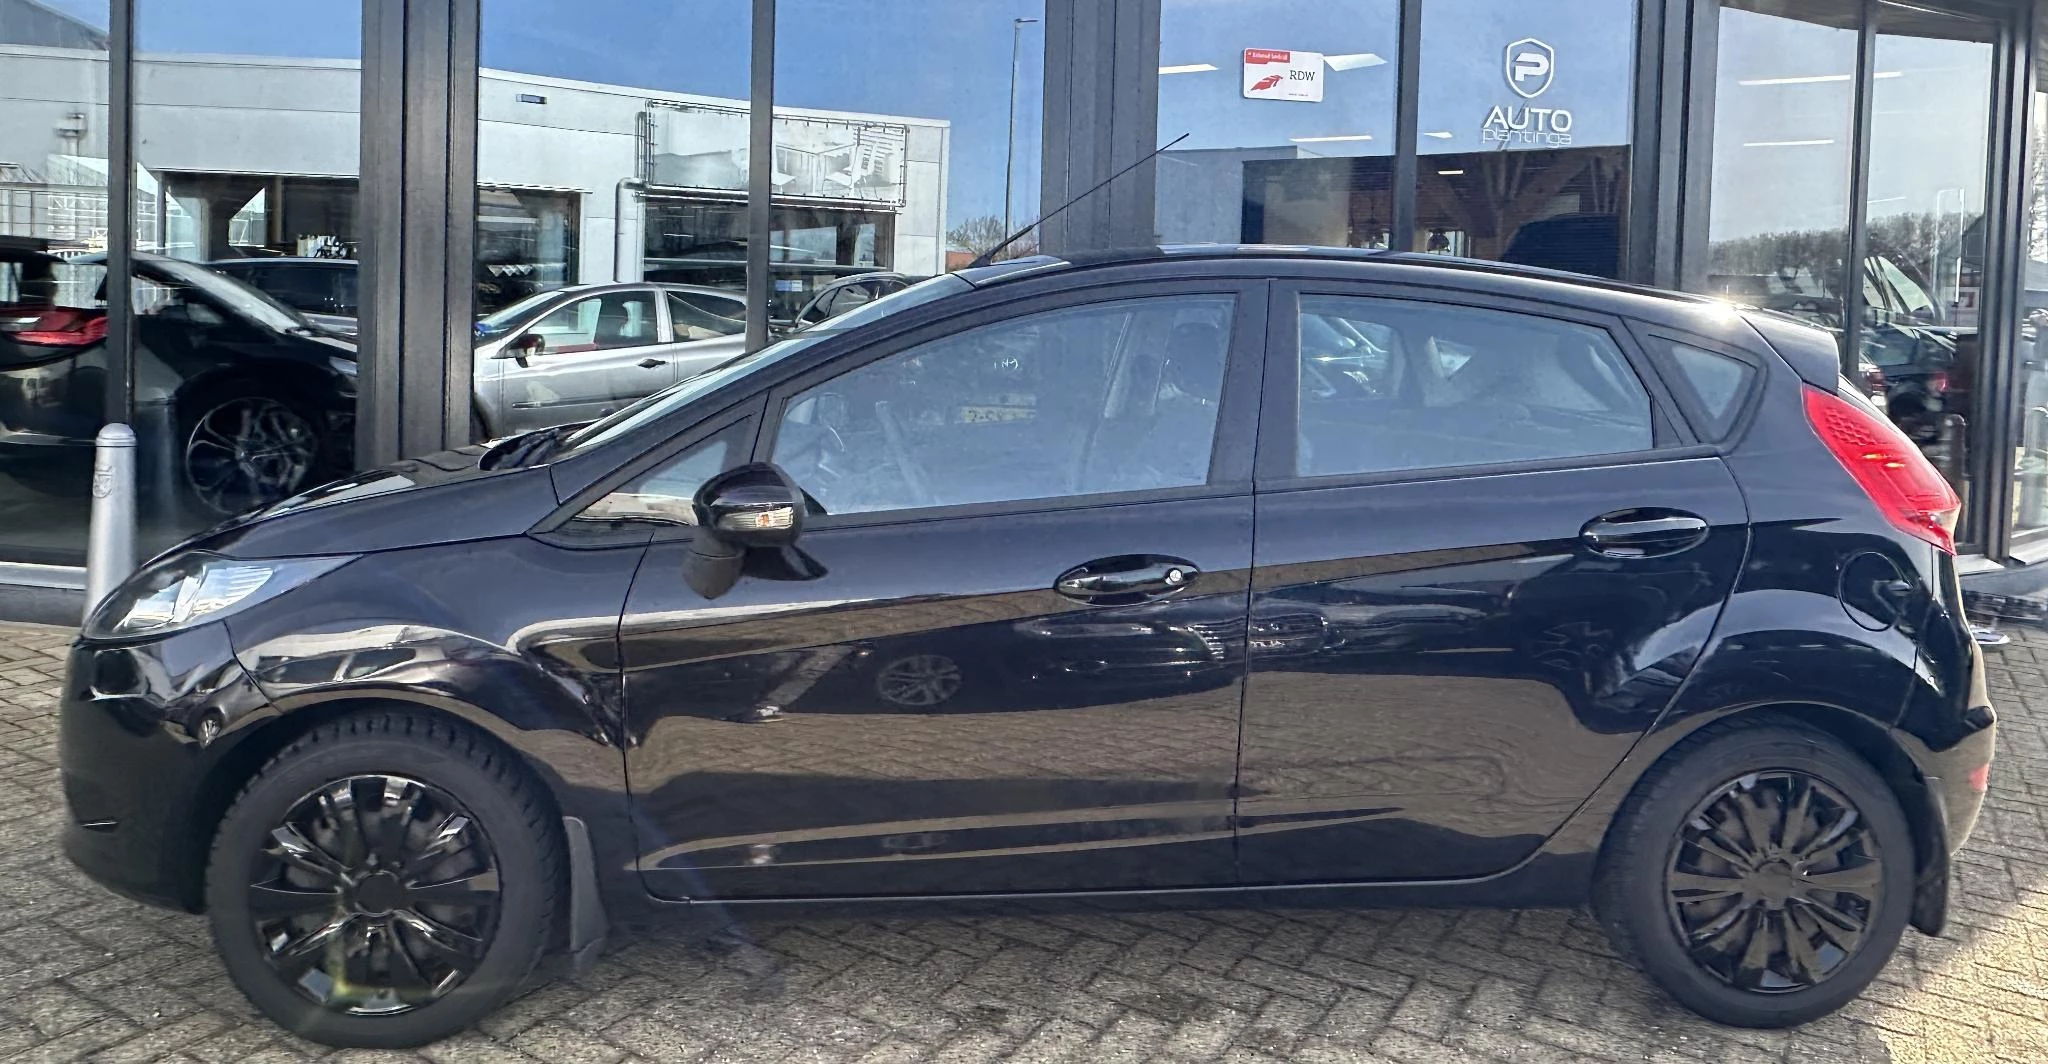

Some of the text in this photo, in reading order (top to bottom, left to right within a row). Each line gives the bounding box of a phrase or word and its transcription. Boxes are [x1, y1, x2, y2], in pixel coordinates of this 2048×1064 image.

[1289, 69, 1316, 81] RDW
[1514, 52, 1549, 81] P
[1483, 105, 1572, 132] AUTO
[1482, 127, 1572, 148] plantinga
